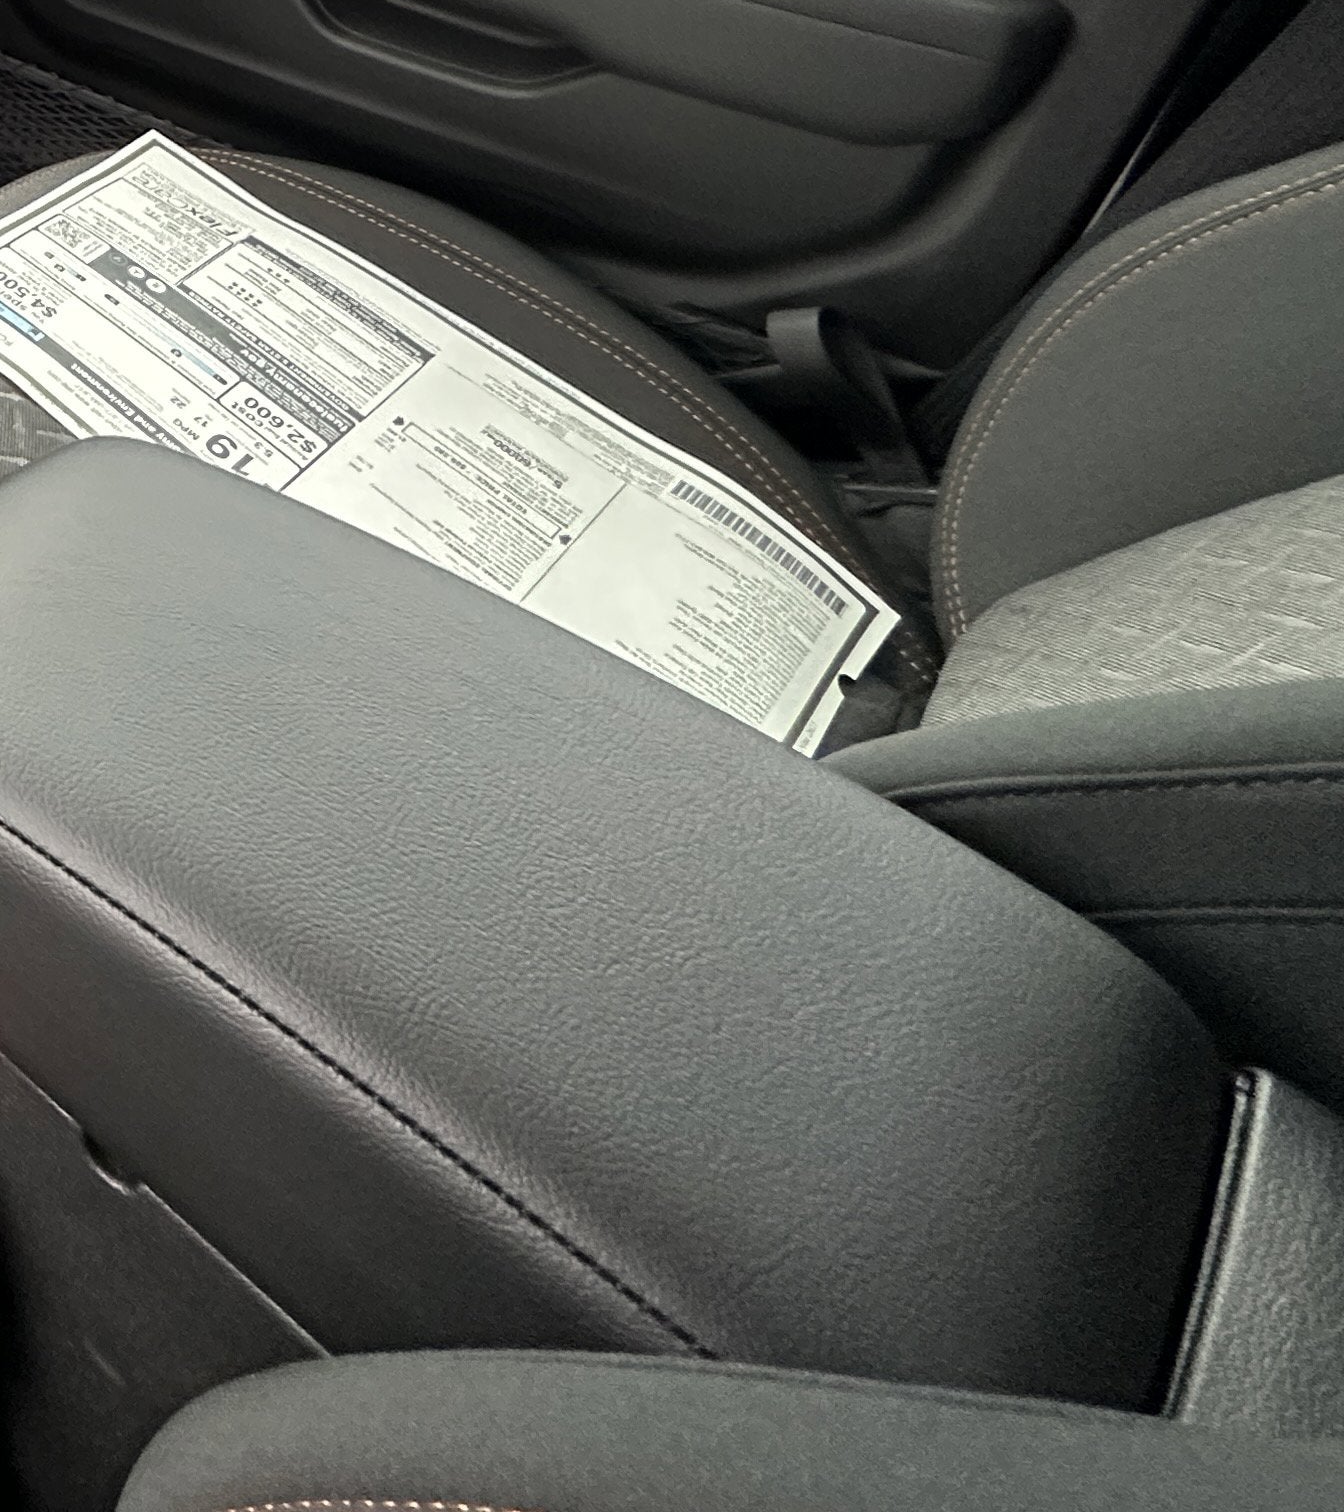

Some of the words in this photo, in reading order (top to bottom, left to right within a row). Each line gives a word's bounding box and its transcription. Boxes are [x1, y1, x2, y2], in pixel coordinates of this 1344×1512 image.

[130, 173, 238, 237] FlexCare
[70, 362, 135, 417] Environment
[167, 395, 187, 410] 22
[132, 413, 157, 433] and
[192, 414, 210, 428] 17
[228, 400, 265, 428] cost
[239, 394, 320, 455] $2,600
[170, 417, 201, 441] MPG
[200, 430, 262, 478] 19
[251, 440, 275, 458] 5.3
